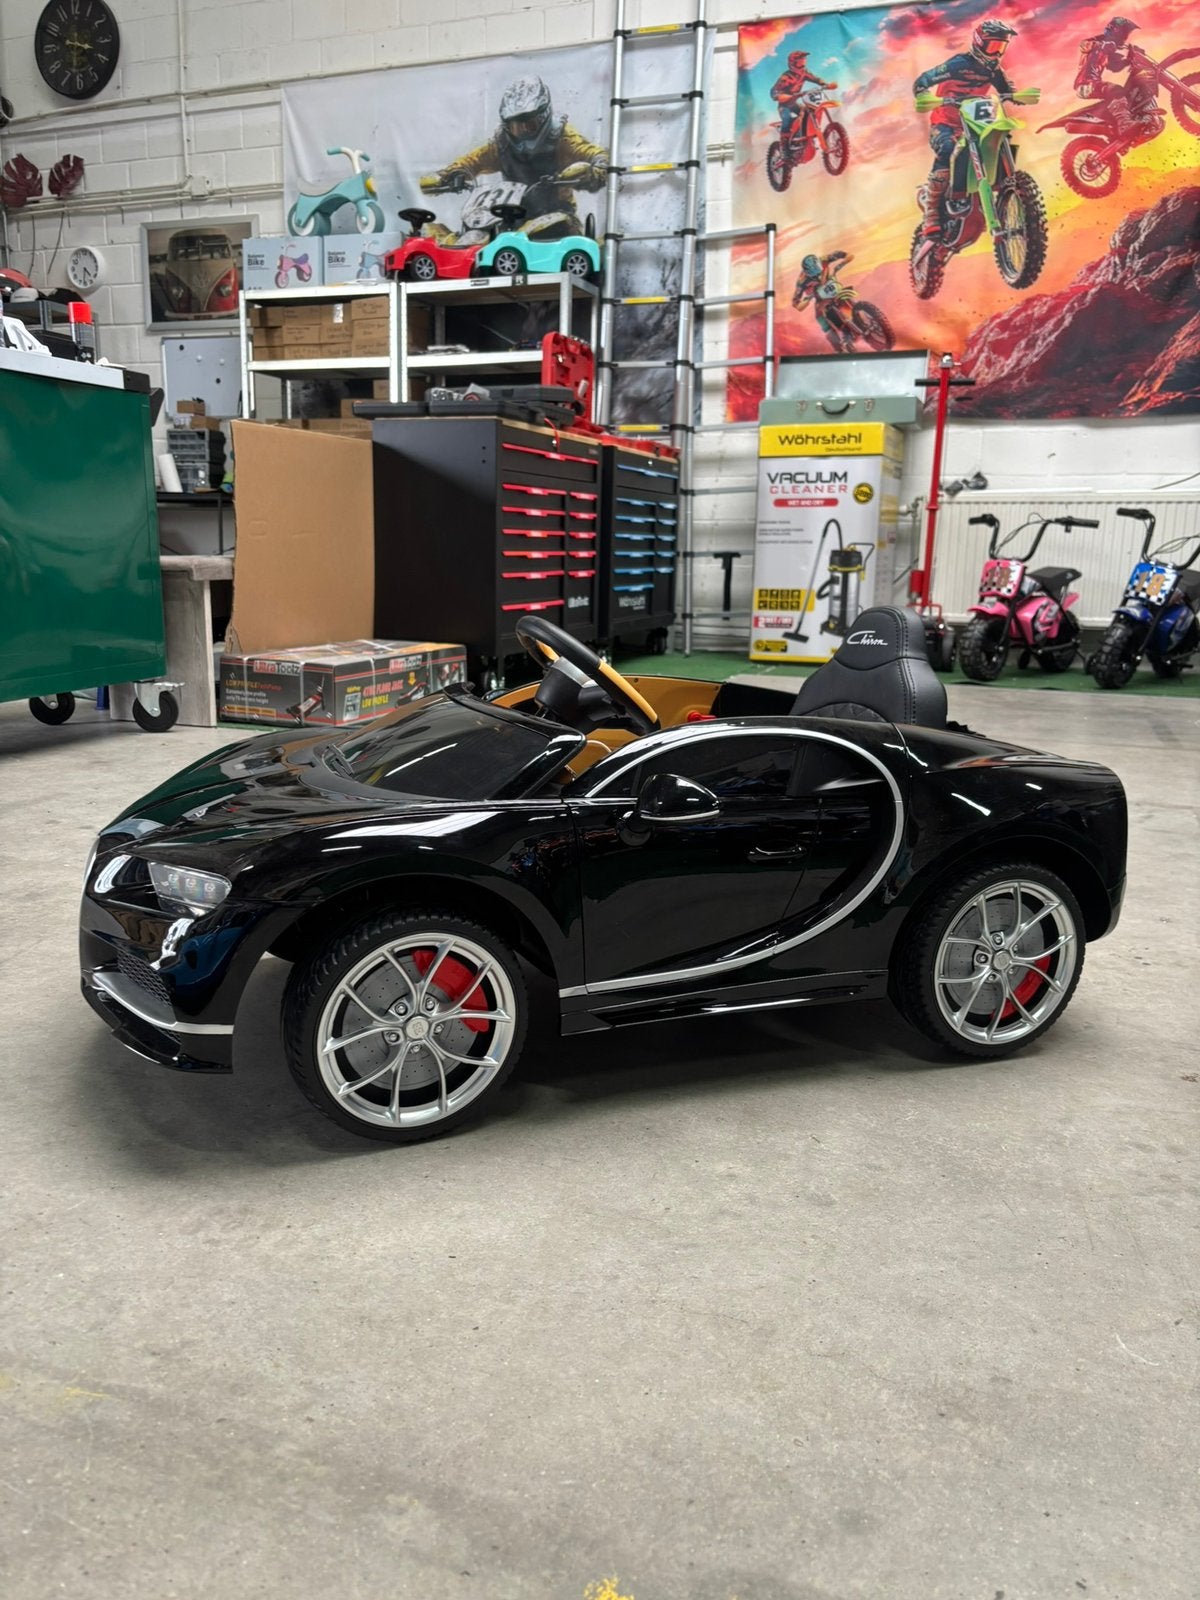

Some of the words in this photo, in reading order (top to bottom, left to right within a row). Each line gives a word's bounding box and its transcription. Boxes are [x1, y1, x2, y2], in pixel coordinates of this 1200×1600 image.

[56, 4, 68, 22] 11
[86, 2, 92, 17] 1
[94, 14, 107, 28] 2
[49, 60, 61, 74] 8
[61, 70, 71, 87] 7
[76, 73, 84, 90] 6
[247, 258, 265, 266] Bike
[327, 256, 345, 264] Bike
[778, 433, 862, 446] Wöhrstahl
[767, 471, 848, 484] VACUUM
[769, 484, 848, 495] CLEANER
[1135, 571, 1166, 597] 18
[847, 630, 888, 646] Chiron
